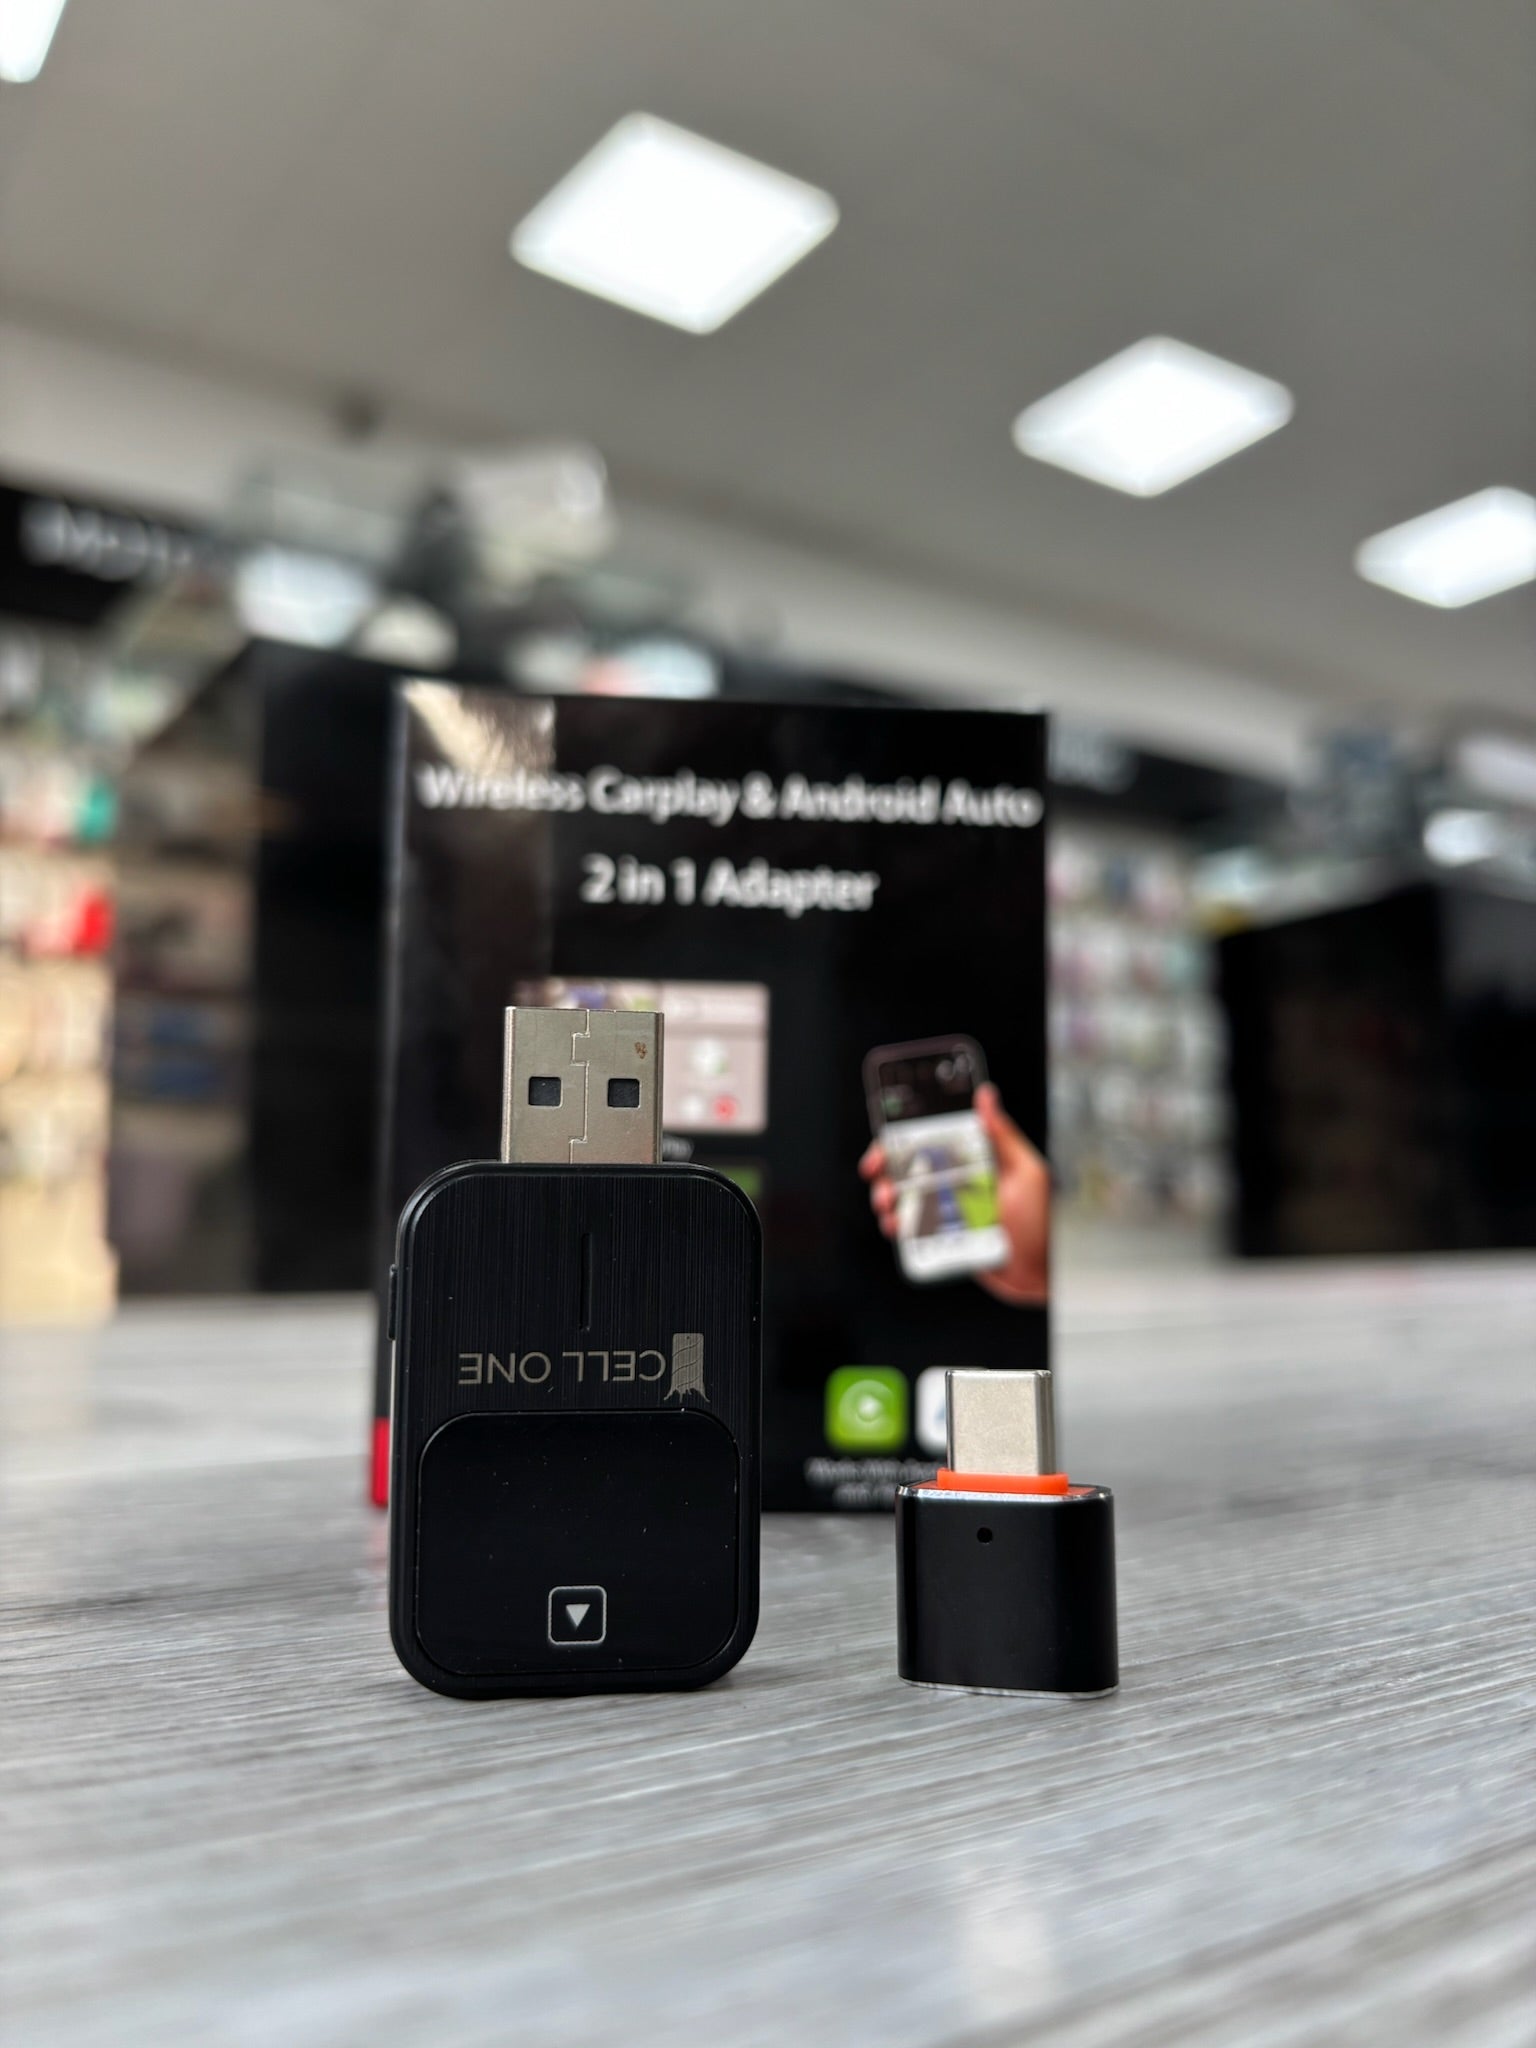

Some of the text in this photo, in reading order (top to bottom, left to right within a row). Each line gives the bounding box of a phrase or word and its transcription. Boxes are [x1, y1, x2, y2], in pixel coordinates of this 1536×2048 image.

[418, 766, 1044, 827] Wireless Carplay & Android Auto
[583, 854, 878, 916] 2 in 1 Adapter
[458, 1351, 666, 1384] CELL ONE
